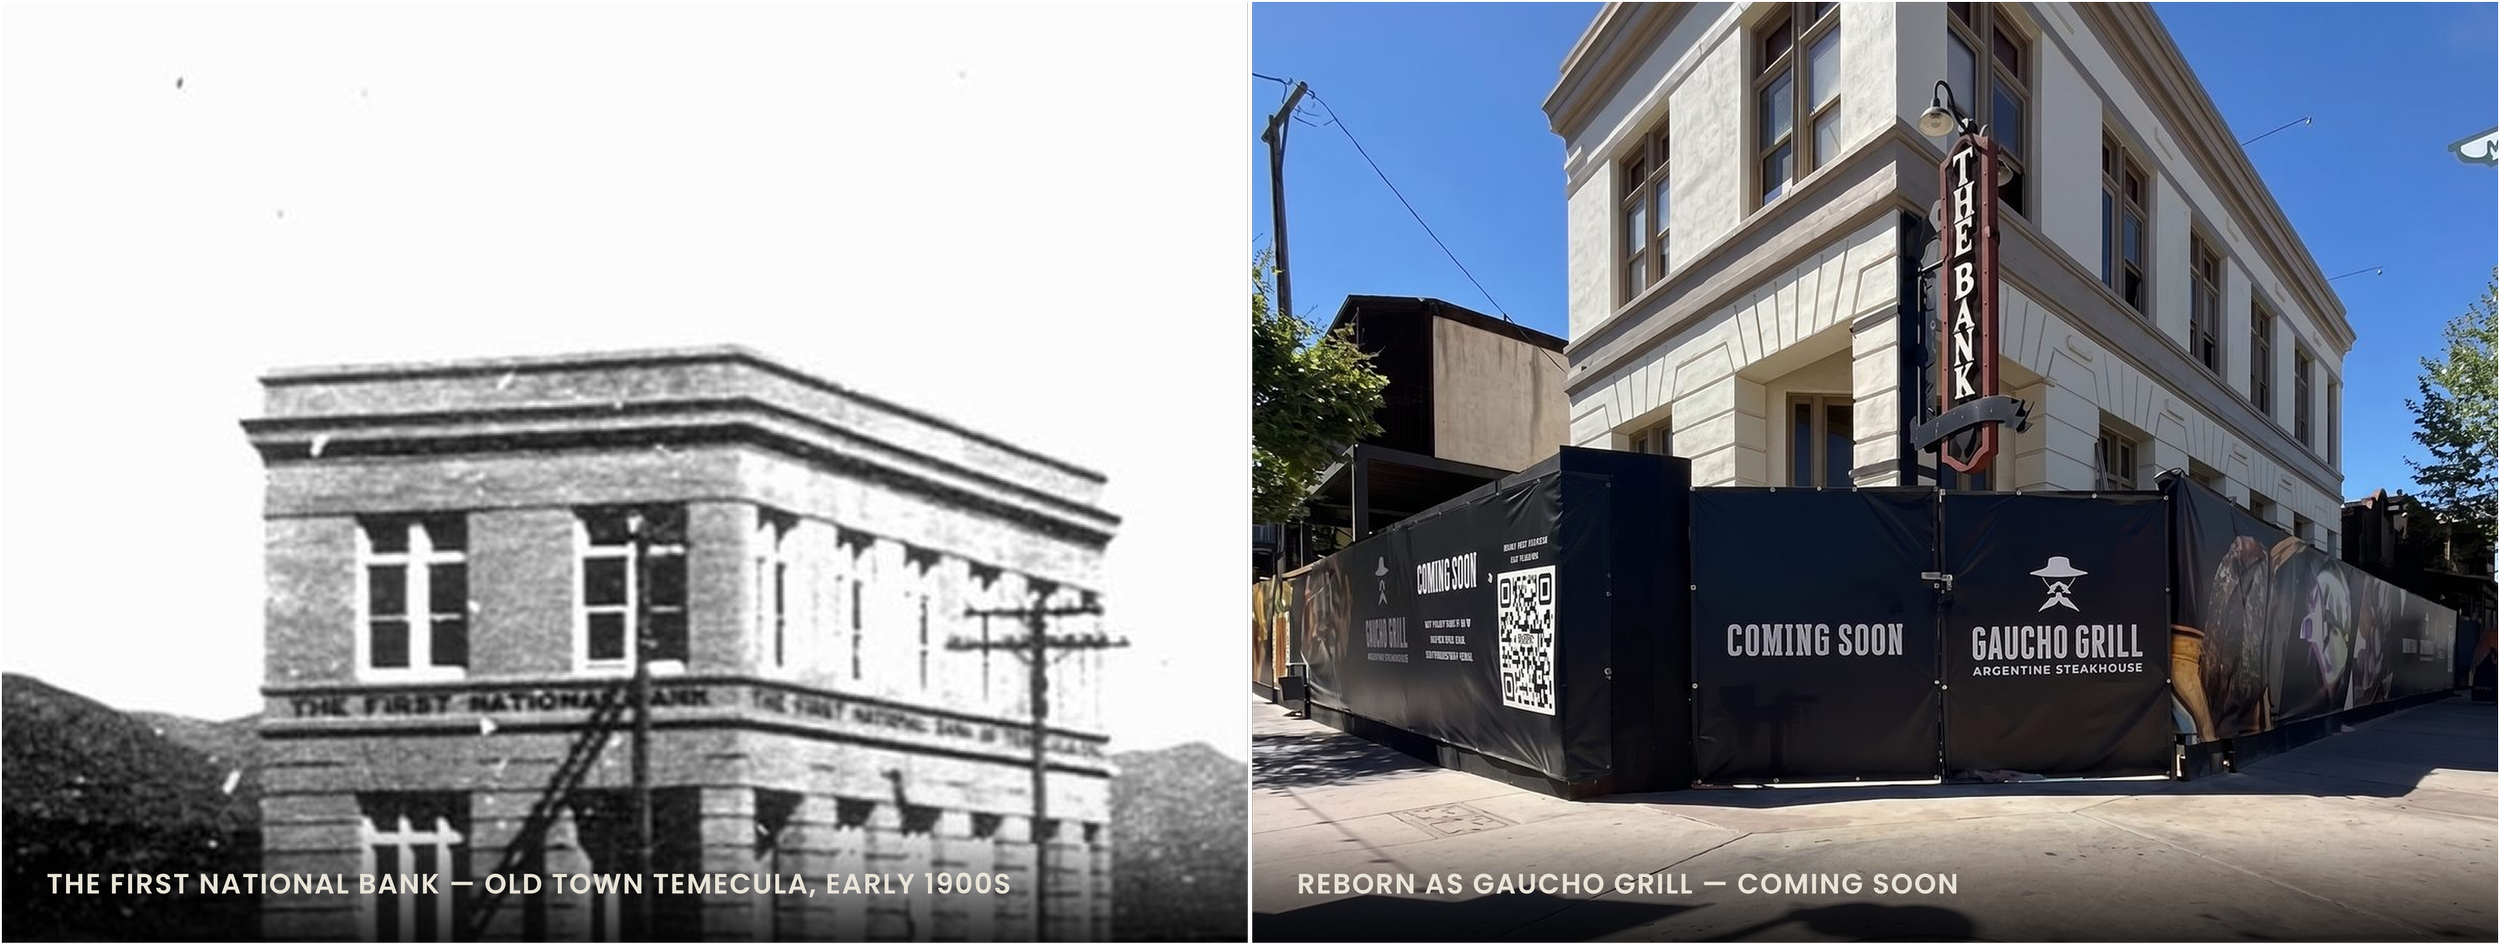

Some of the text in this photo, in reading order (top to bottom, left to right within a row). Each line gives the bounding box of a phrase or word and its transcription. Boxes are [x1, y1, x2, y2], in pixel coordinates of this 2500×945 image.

[1952, 146, 1976, 400] THE BANK
[1416, 551, 1478, 595] COMING SOON
[1727, 623, 1904, 657] COMING SOON
[1971, 623, 2144, 661] GAUCHO GRILL
[1972, 662, 2143, 677] ARGENTINE STEAKHOUSE
[292, 695, 349, 718] THE
[364, 691, 452, 716] FIRST
[468, 688, 618, 713] NATIONA
